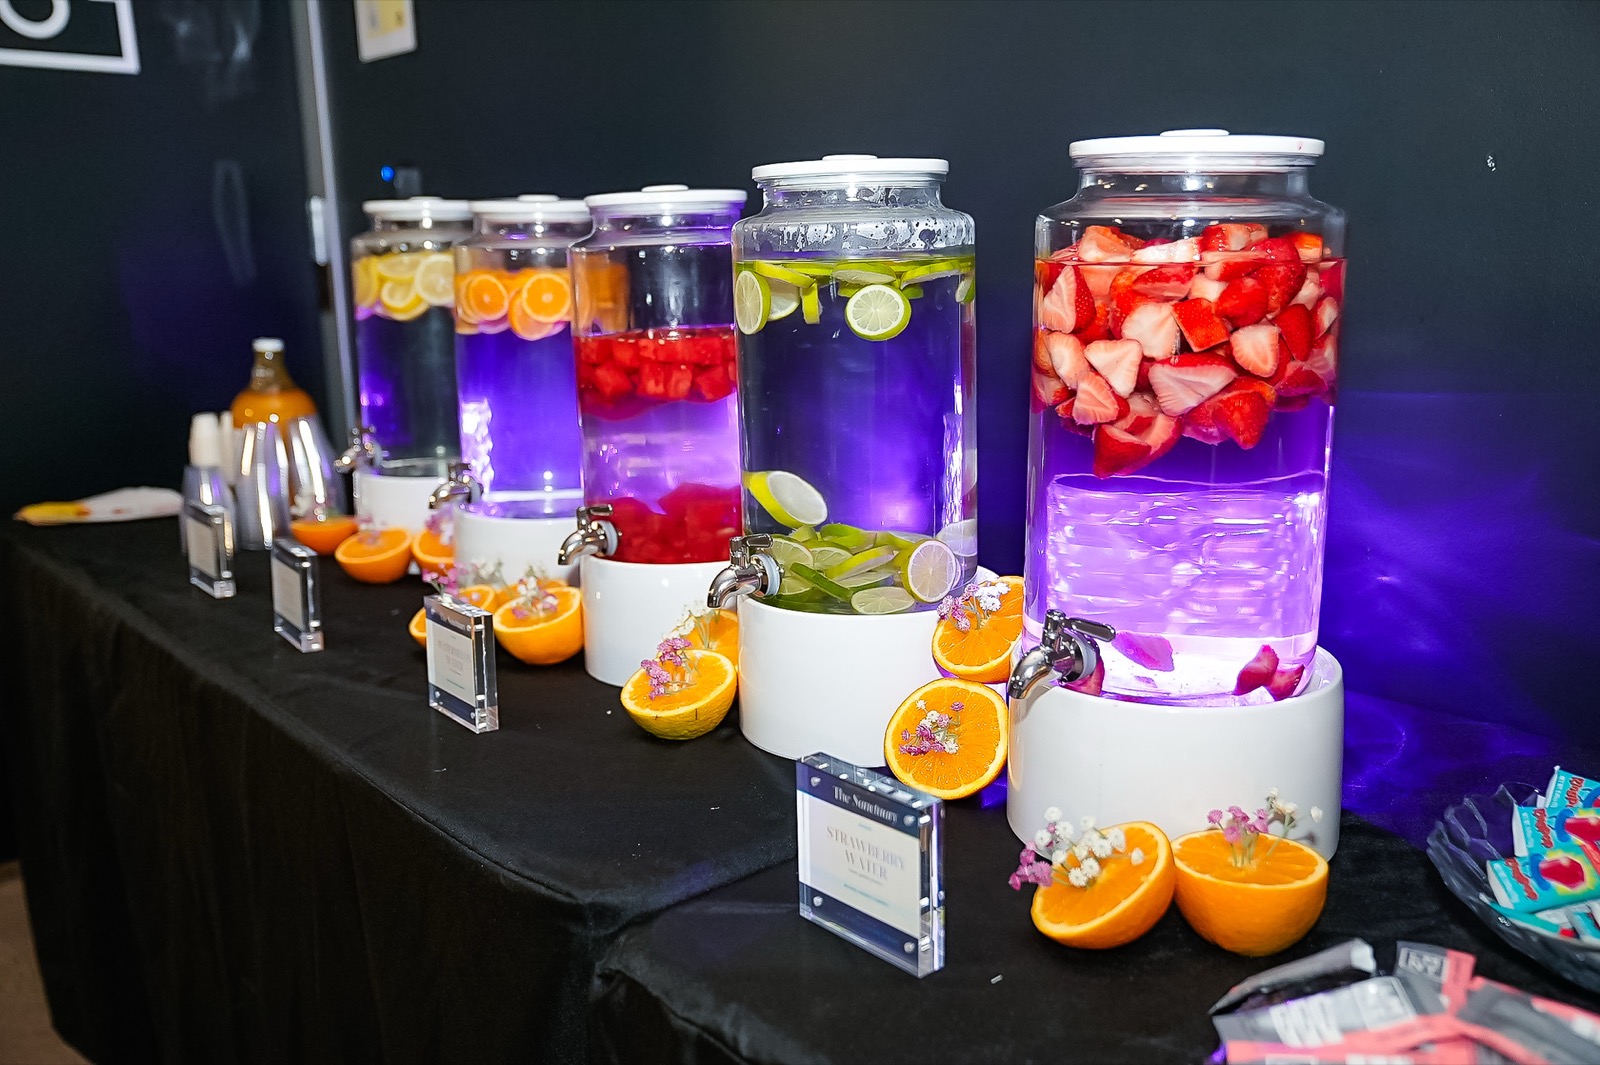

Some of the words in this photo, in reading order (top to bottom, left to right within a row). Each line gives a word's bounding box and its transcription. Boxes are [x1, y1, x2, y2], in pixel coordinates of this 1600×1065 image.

[833, 786, 851, 804] The
[852, 794, 898, 824] Sanctuary
[826, 826, 904, 870] STRAWBERRY
[845, 849, 887, 880] WATER
